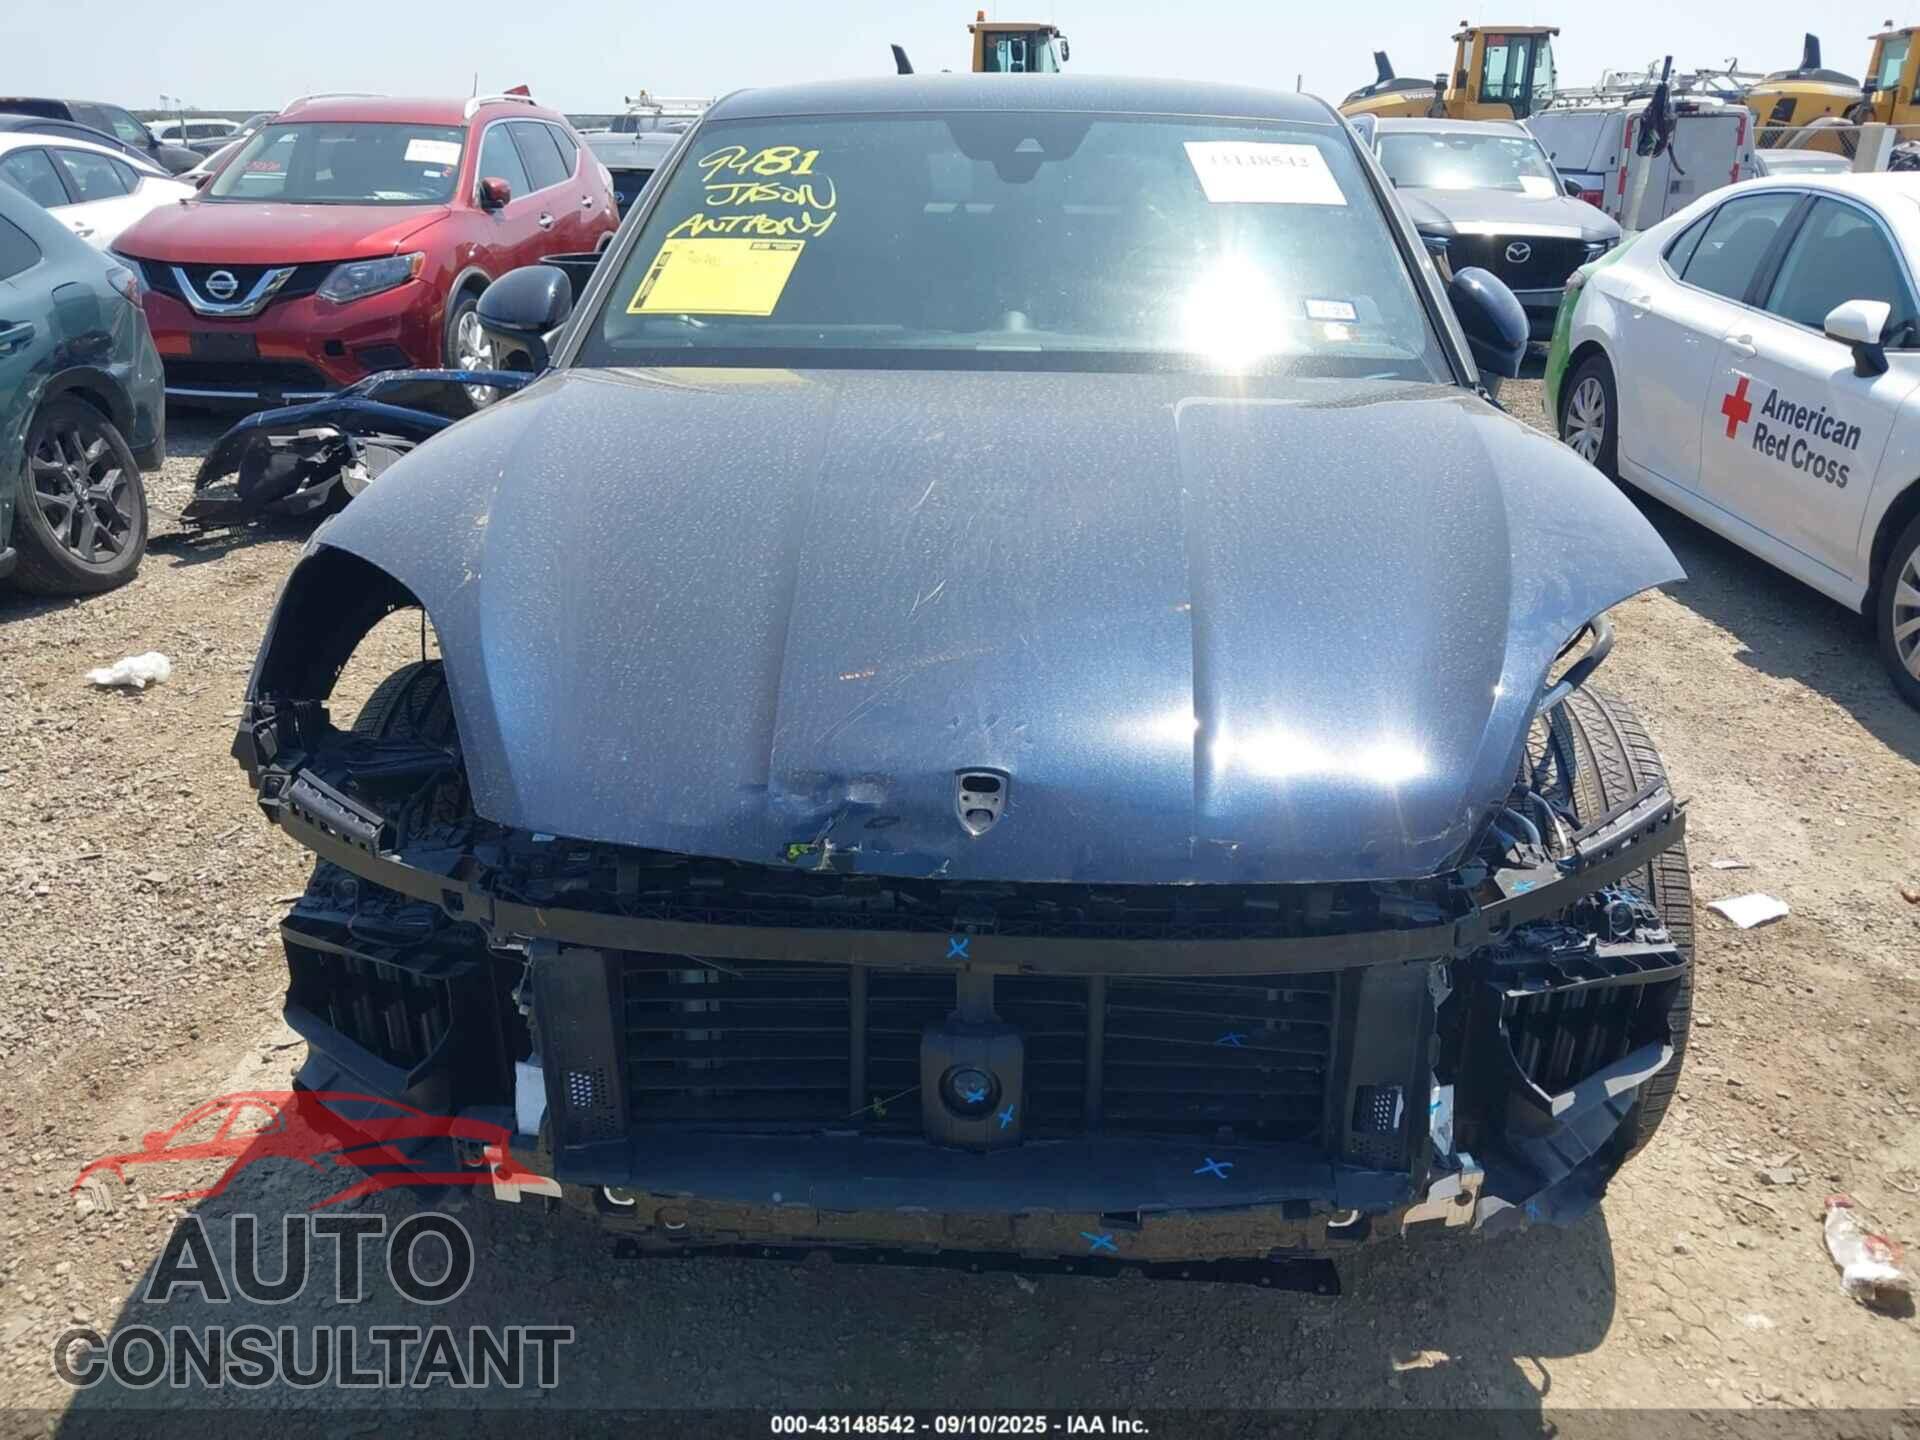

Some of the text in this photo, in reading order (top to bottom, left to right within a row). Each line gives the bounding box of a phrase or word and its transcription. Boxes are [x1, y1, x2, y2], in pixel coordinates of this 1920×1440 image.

[1761, 388, 1861, 450] American
[1752, 421, 1849, 489] Red Cross
